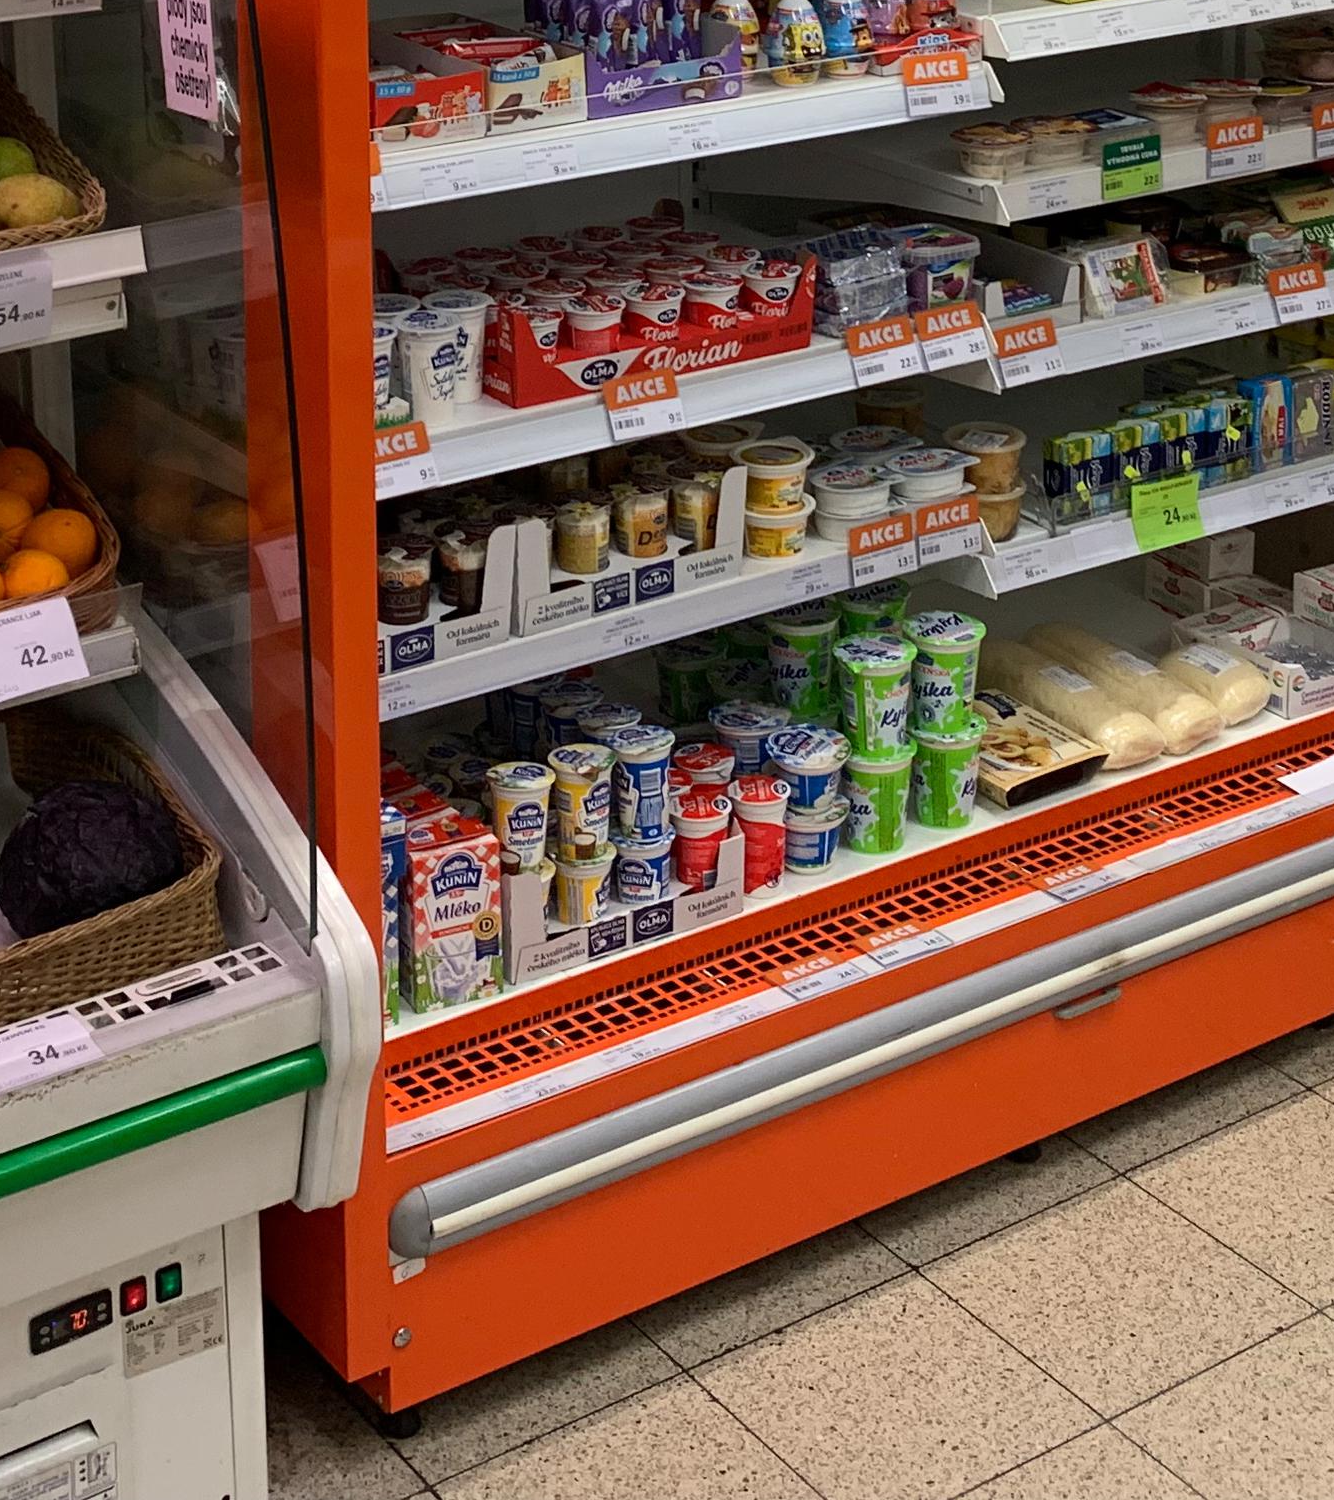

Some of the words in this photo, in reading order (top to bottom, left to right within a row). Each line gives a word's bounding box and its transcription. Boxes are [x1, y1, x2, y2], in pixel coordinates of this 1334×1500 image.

[171, 29, 208, 71] chemicky
[913, 58, 961, 80] AKCE
[604, 75, 644, 99] Milka
[1216, 121, 1256, 145] AKCE
[1278, 269, 1317, 292] AKCE
[926, 307, 973, 334] AKCE
[858, 323, 903, 349] AKCE
[1004, 325, 1049, 353] AKCE
[643, 338, 744, 373] Florian
[583, 365, 616, 382] OLMA
[616, 377, 667, 403] AKCE
[925, 502, 971, 529] AKCE
[859, 523, 904, 550] AKCE
[640, 573, 673, 591] OLMA
[398, 638, 432, 658] OLMA
[1043, 864, 1093, 887] AKCE
[434, 901, 482, 923] Mléko
[638, 913, 668, 931] OLMA
[868, 923, 921, 949] AKCE
[780, 955, 834, 981] AKCE
[125, 1318, 155, 1335] JUKA
